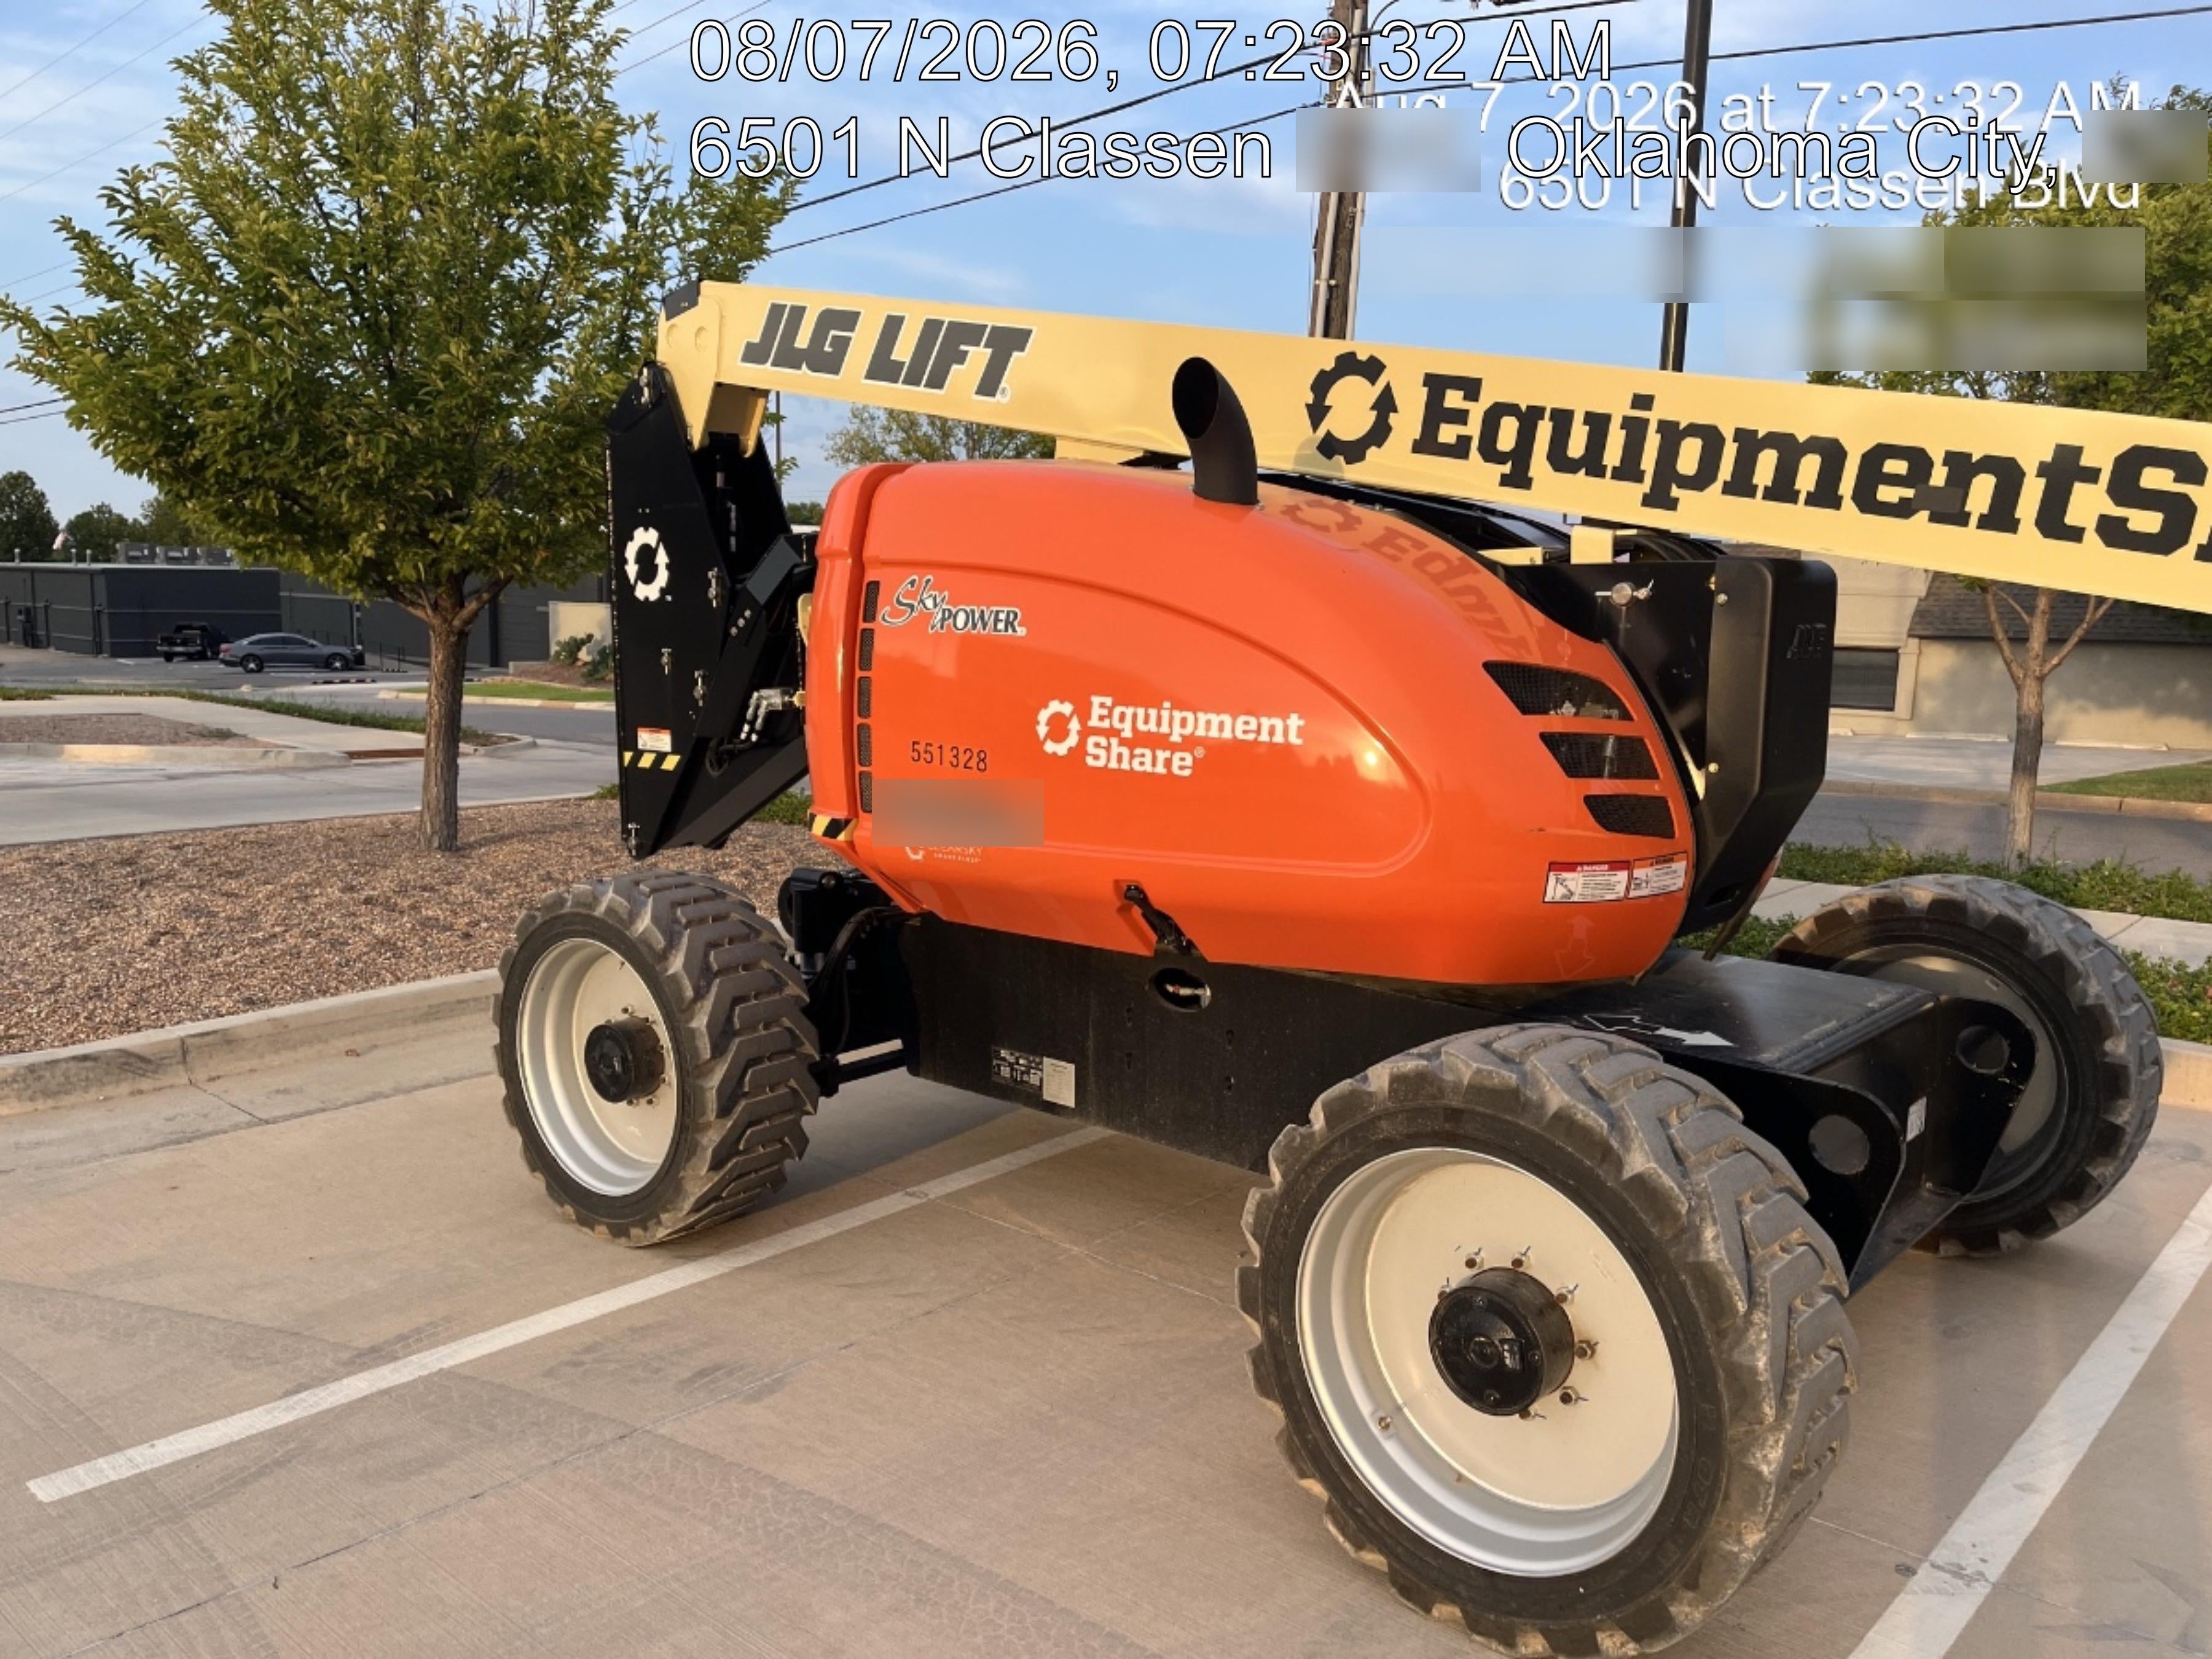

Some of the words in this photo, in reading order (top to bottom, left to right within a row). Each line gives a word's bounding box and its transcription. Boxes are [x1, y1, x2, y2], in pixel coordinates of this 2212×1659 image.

[740, 302, 861, 377] JLG
[1411, 371, 2212, 563] EquipmentS
[880, 575, 947, 632] Sky
[1087, 694, 1306, 745] Equipment
[911, 740, 988, 773] 551328
